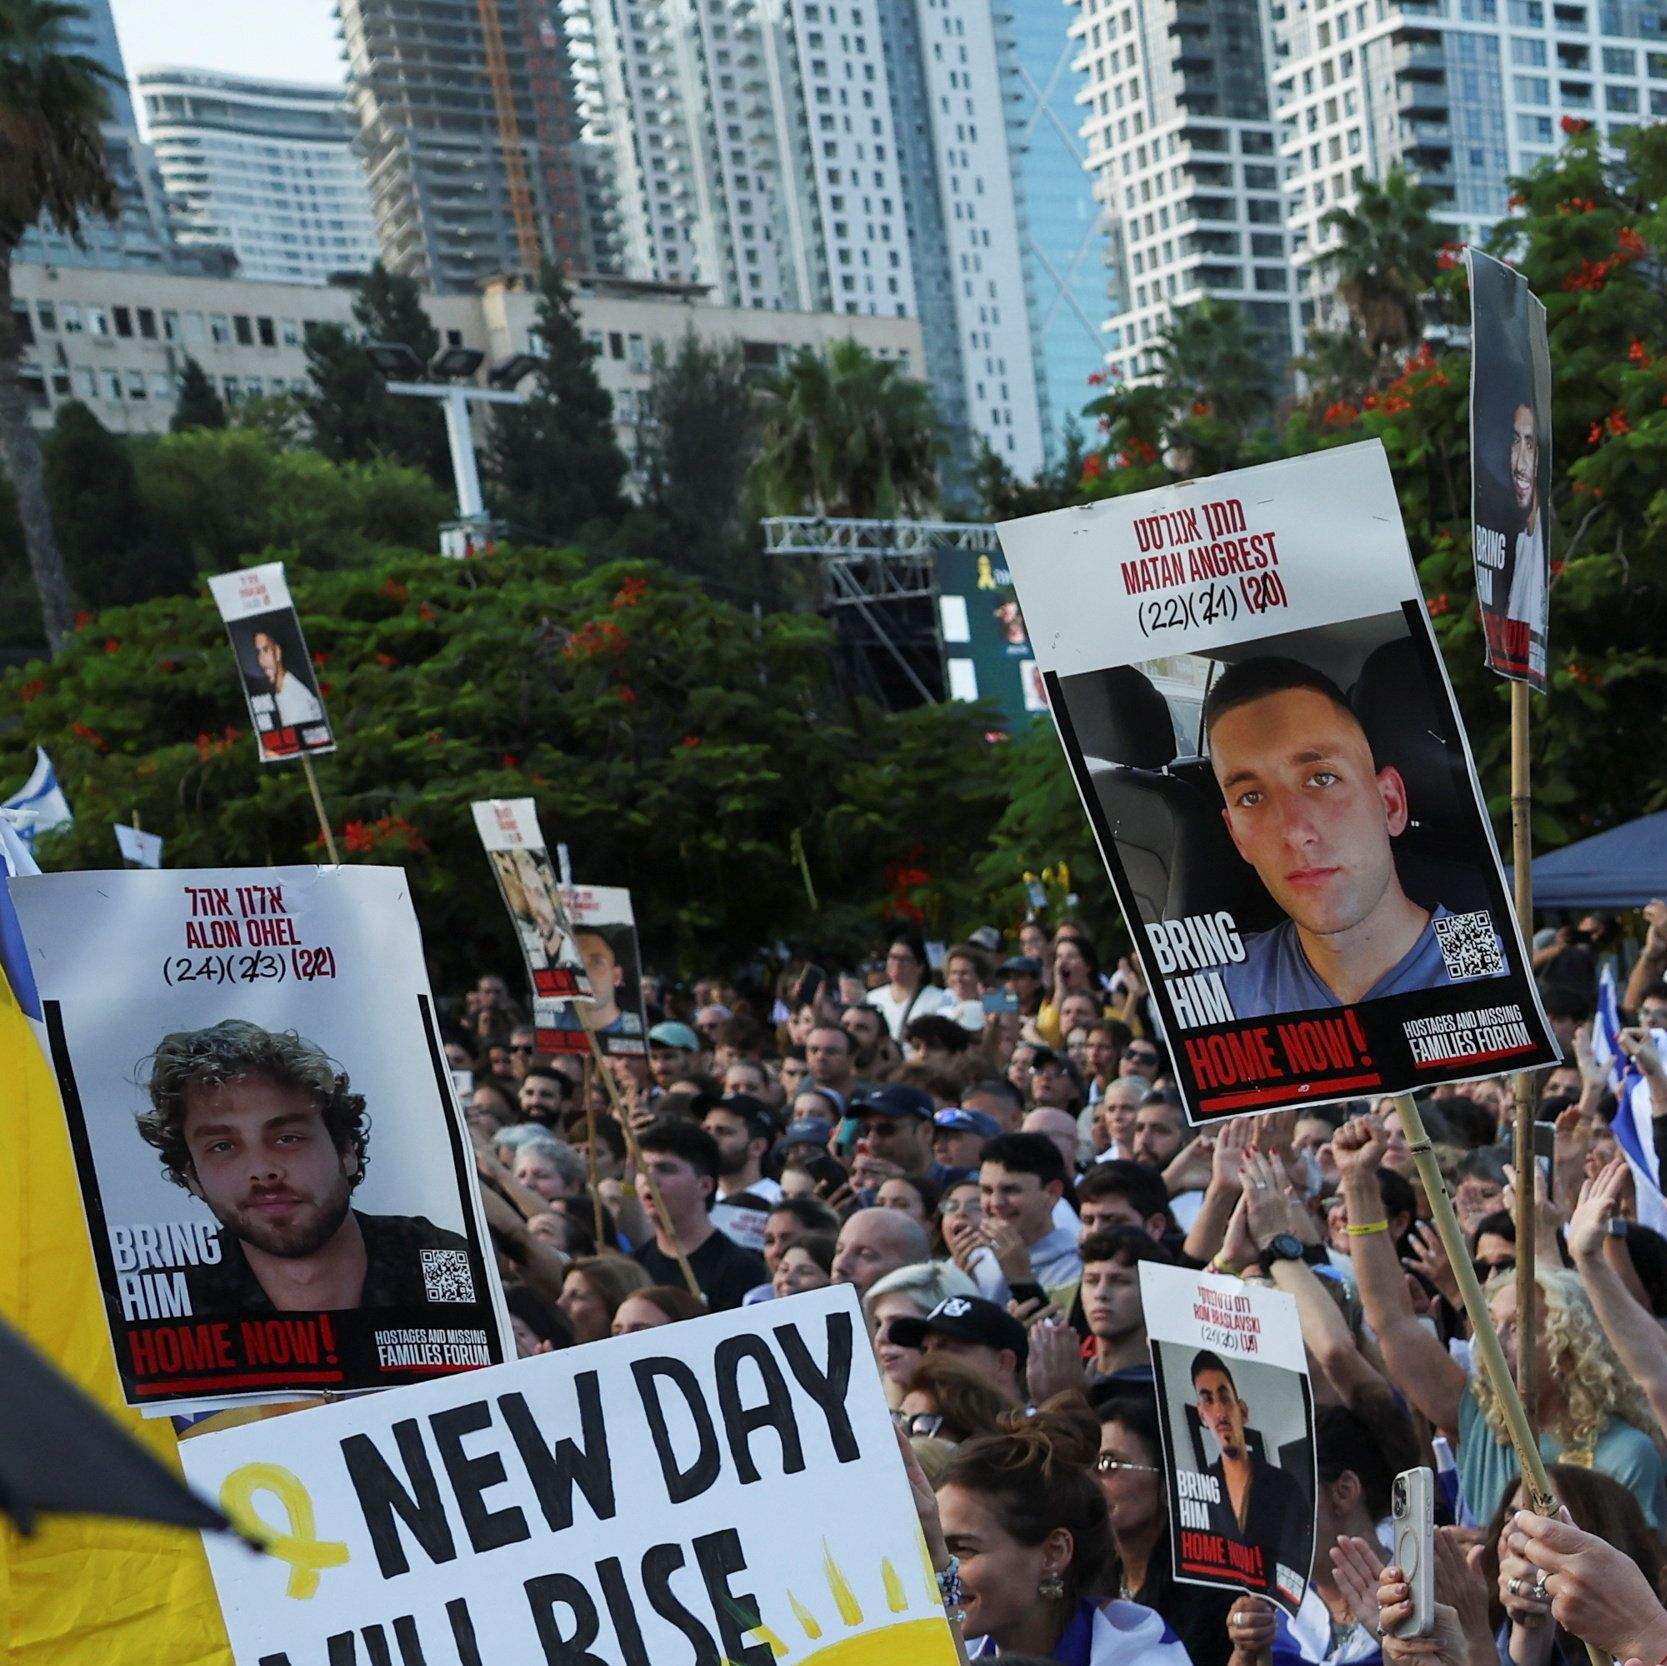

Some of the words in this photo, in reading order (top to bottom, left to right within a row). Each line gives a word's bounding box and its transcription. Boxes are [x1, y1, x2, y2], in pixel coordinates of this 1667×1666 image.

[1133, 507, 1202, 552] אנגרסט
[1201, 499, 1247, 541] מתן
[1121, 552, 1186, 595] MATAN
[1188, 532, 1279, 582] ANGREST
[1476, 524, 1506, 570] BRING
[185, 886, 231, 917] אהל
[236, 885, 287, 915] אלון
[185, 919, 242, 950] ALON
[247, 917, 301, 947] OHEL
[1144, 910, 1246, 973] BRING
[1164, 974, 1236, 1030] HIM
[1403, 1015, 1454, 1036] HOSTAGES
[1454, 1011, 1475, 1029] AND
[1475, 1004, 1521, 1026] MISSING
[1185, 1023, 1275, 1090] HOME
[1274, 1008, 1370, 1076] NOW!
[1409, 1030, 1476, 1063] FAMILIES
[1476, 1023, 1531, 1051] FORUM
[110, 1222, 223, 1273] BRING
[118, 1272, 193, 1321] HIM
[1193, 1303, 1210, 1322] ROM
[127, 1323, 236, 1376] HOME
[240, 1314, 339, 1370] NOW!
[375, 1329, 427, 1345] HOSTAGES
[428, 1329, 446, 1343] AND
[447, 1329, 487, 1344] MISSING
[378, 1344, 442, 1366] FAMILIES
[443, 1344, 491, 1365] FORUM
[340, 1368, 615, 1580] NEW
[629, 1311, 863, 1504] DAY
[1176, 1469, 1220, 1504] BRING
[1180, 1498, 1210, 1531] HIM
[1181, 1531, 1226, 1564] HOME
